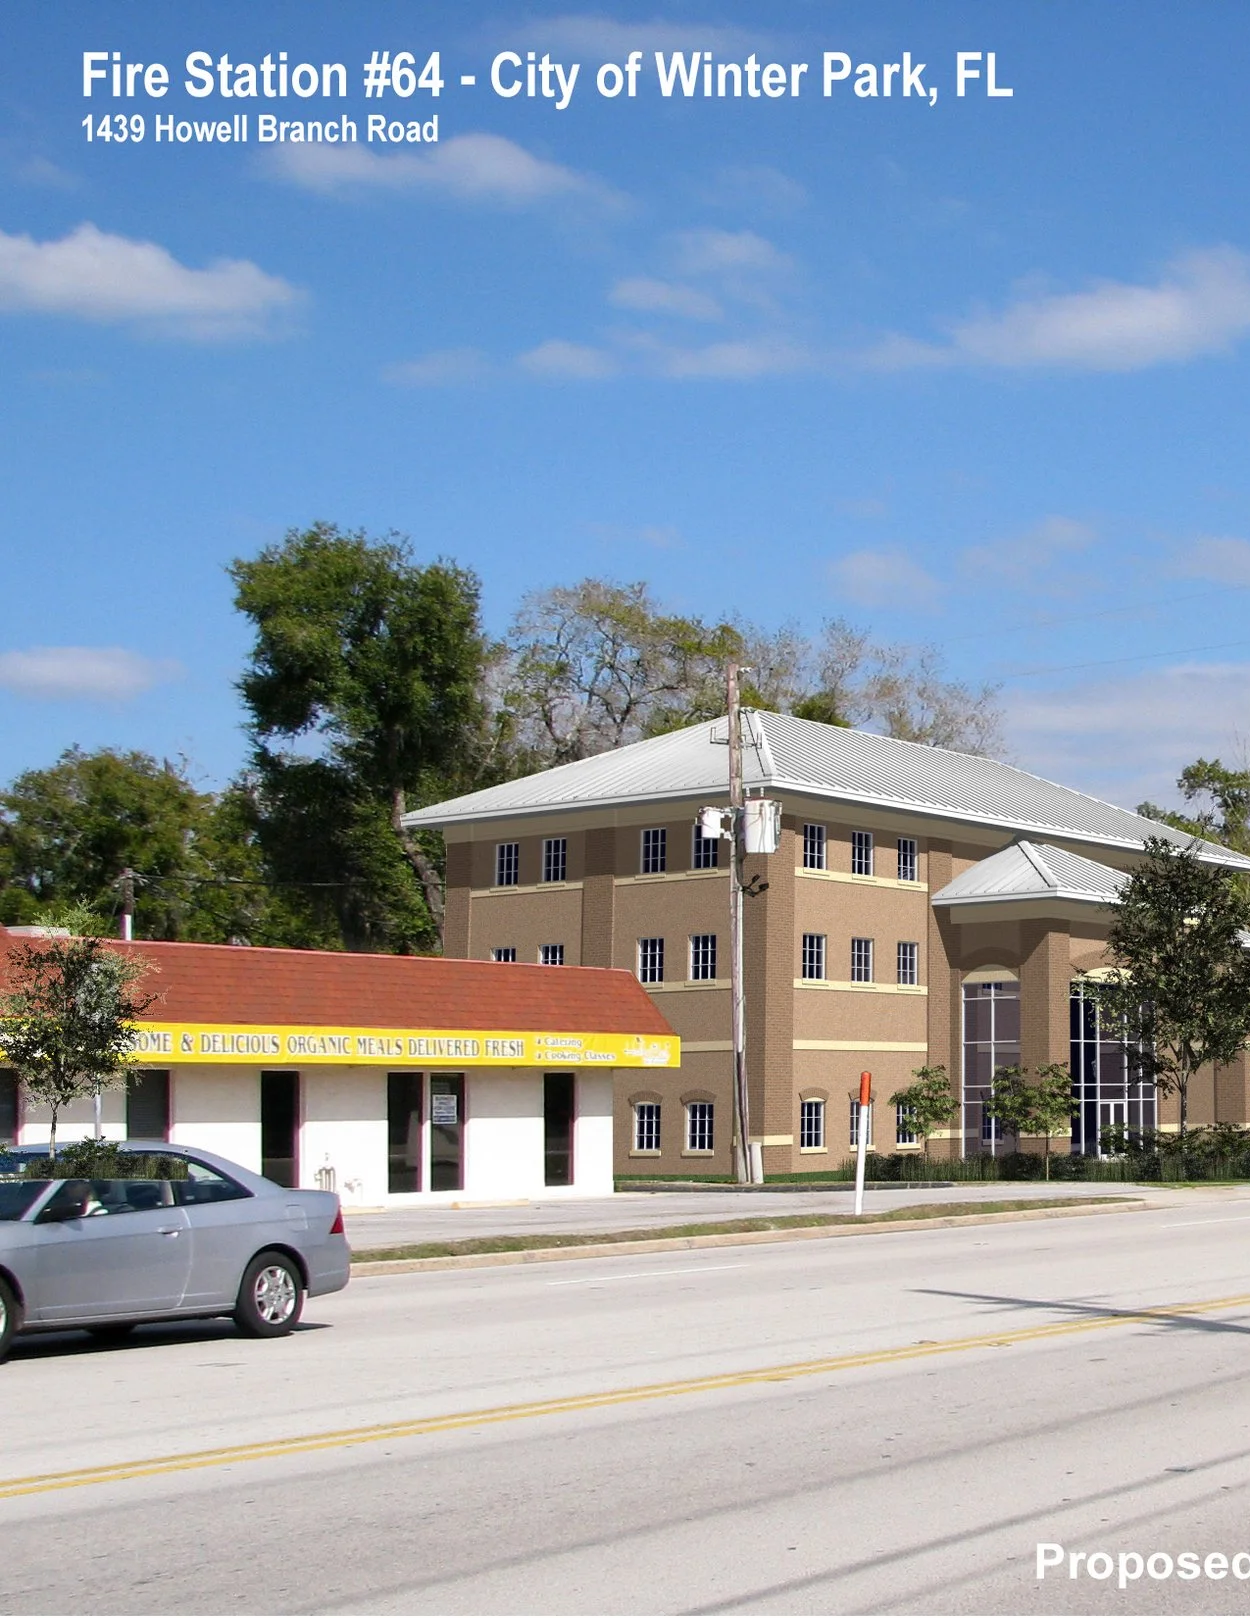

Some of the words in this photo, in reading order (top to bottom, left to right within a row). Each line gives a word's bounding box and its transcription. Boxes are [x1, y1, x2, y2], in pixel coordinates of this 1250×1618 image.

[180, 1033, 194, 1052] &
[200, 1033, 280, 1054] DELICIOUS
[287, 1035, 351, 1054] ORGANIC
[357, 1037, 403, 1056] MEALS
[408, 1038, 480, 1056] DELIVERED
[485, 1039, 525, 1057] FRESH
[544, 1037, 582, 1048] Catering
[544, 1051, 581, 1061] Cooking
[584, 1050, 616, 1061] Classes
